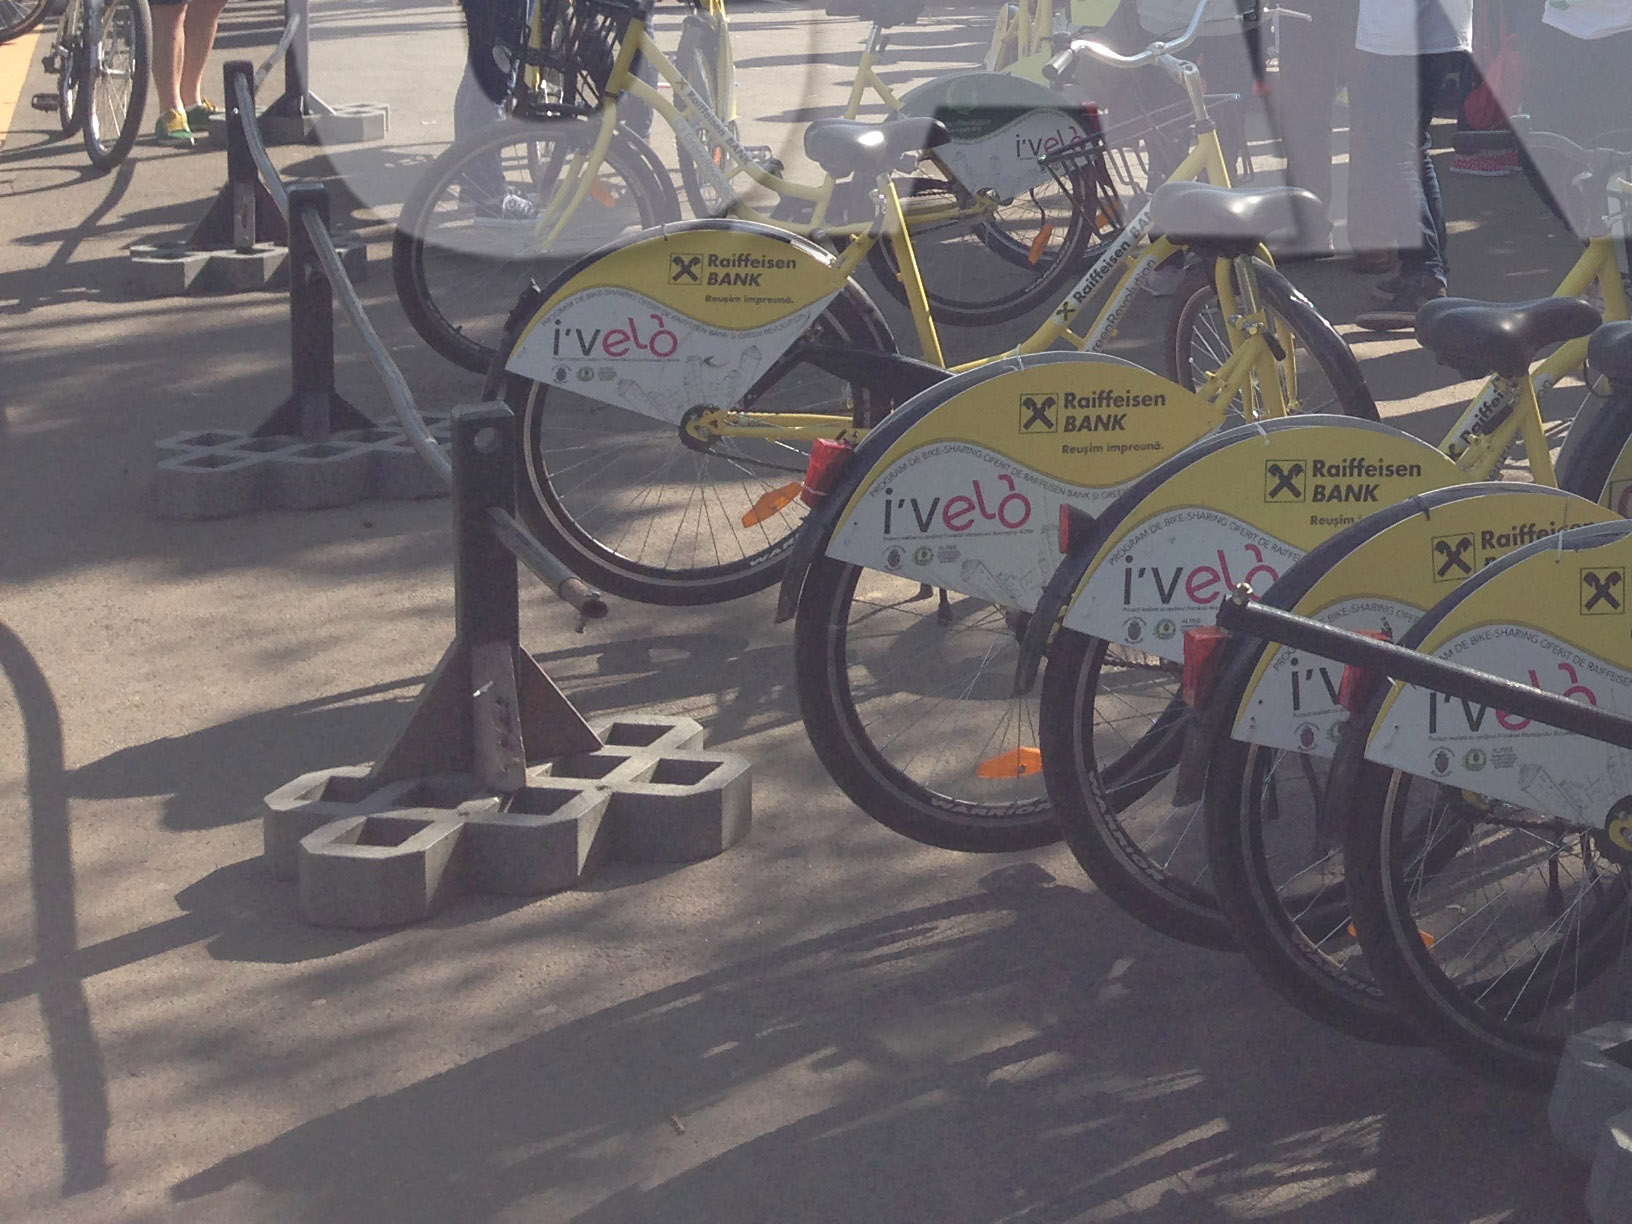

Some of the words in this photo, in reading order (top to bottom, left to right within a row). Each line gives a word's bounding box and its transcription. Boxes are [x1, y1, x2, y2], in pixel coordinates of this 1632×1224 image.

[708, 253, 797, 270] Raiffeisen
[706, 271, 763, 287] BANK
[1072, 239, 1131, 305] Raiffeisen
[1063, 389, 1166, 410] Raiffeisen
[1063, 414, 1128, 433] BANK
[1312, 457, 1422, 479] Raiffeisen
[1311, 483, 1380, 503] BANK
